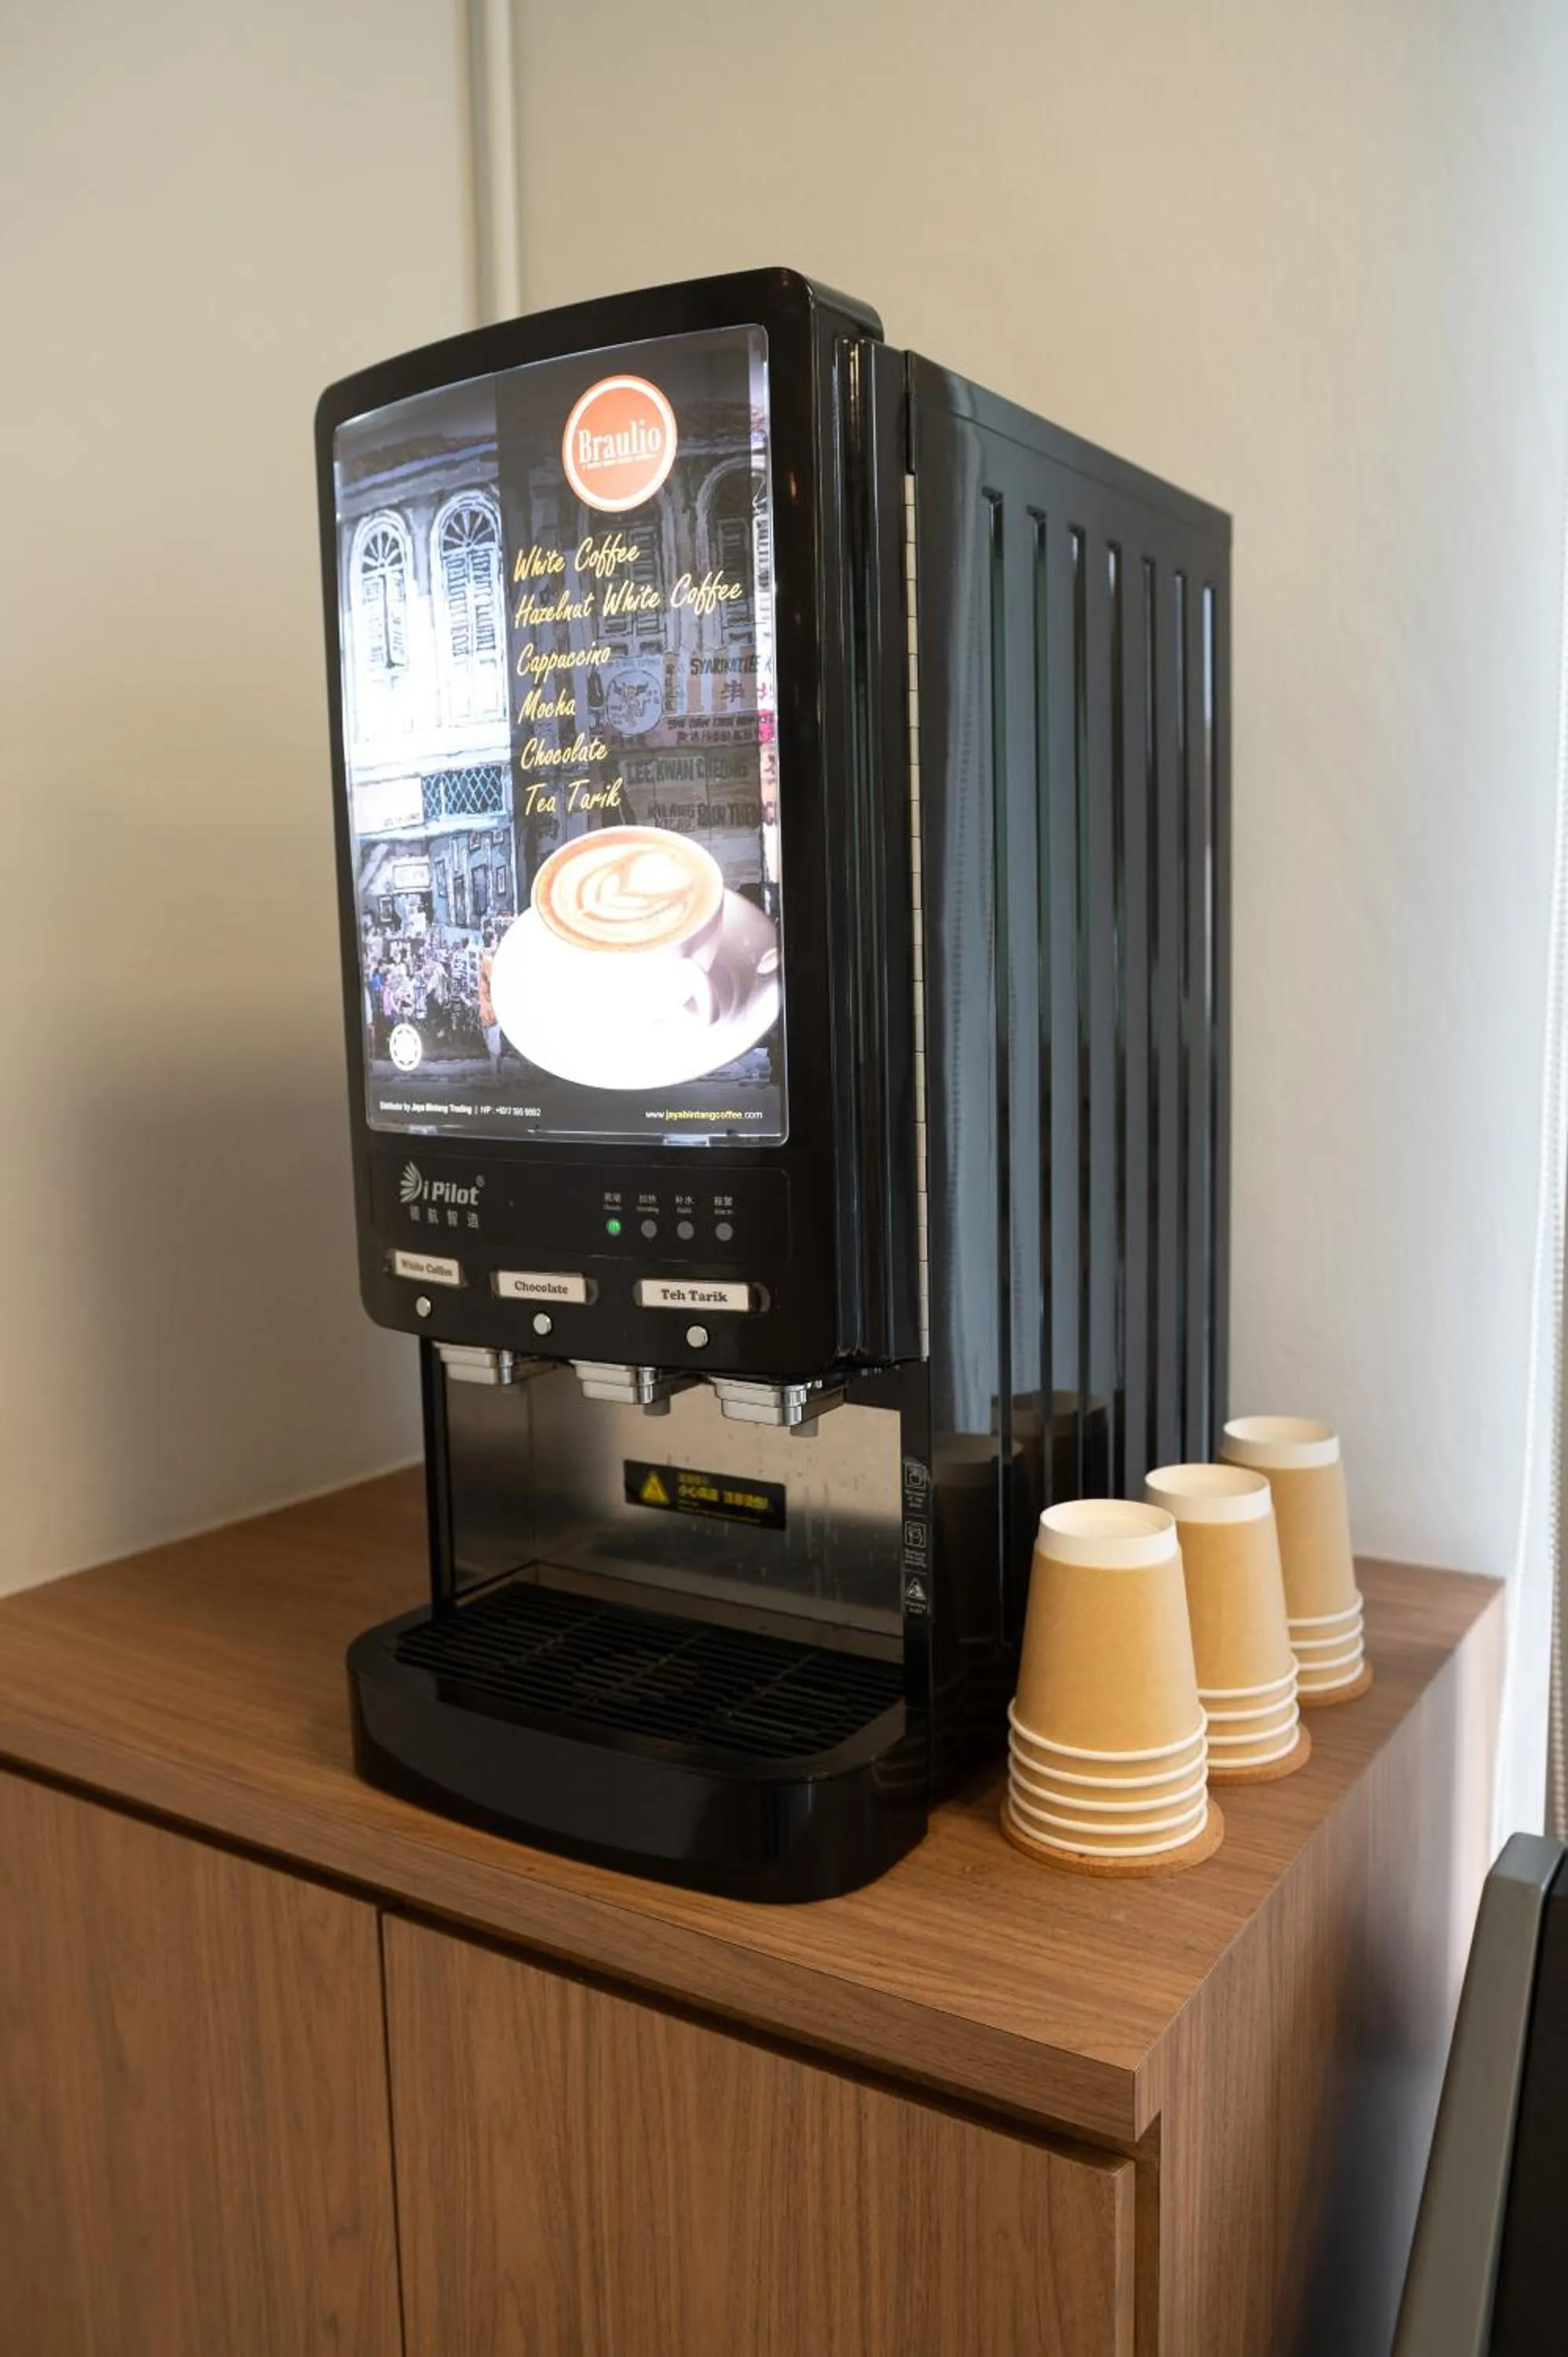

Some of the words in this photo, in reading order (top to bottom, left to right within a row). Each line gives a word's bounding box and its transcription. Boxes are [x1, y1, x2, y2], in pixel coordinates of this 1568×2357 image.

[578, 419, 661, 464] Braulio
[513, 544, 566, 582] White
[574, 533, 640, 578] Coffee
[515, 590, 595, 629] Hazelnut
[603, 580, 661, 617] White
[671, 570, 742, 615] Coffee
[517, 641, 611, 684] Cappuccino
[518, 688, 576, 724] Mocha
[521, 733, 608, 770] Chocolate
[525, 783, 556, 816] Tea
[567, 777, 623, 812] Tarik
[645, 1109, 763, 1121] www.jayabintangcoffee.com
[515, 1281, 569, 1295] Chocolate
[661, 1288, 685, 1300] Teh
[688, 1290, 727, 1303] Tarik
